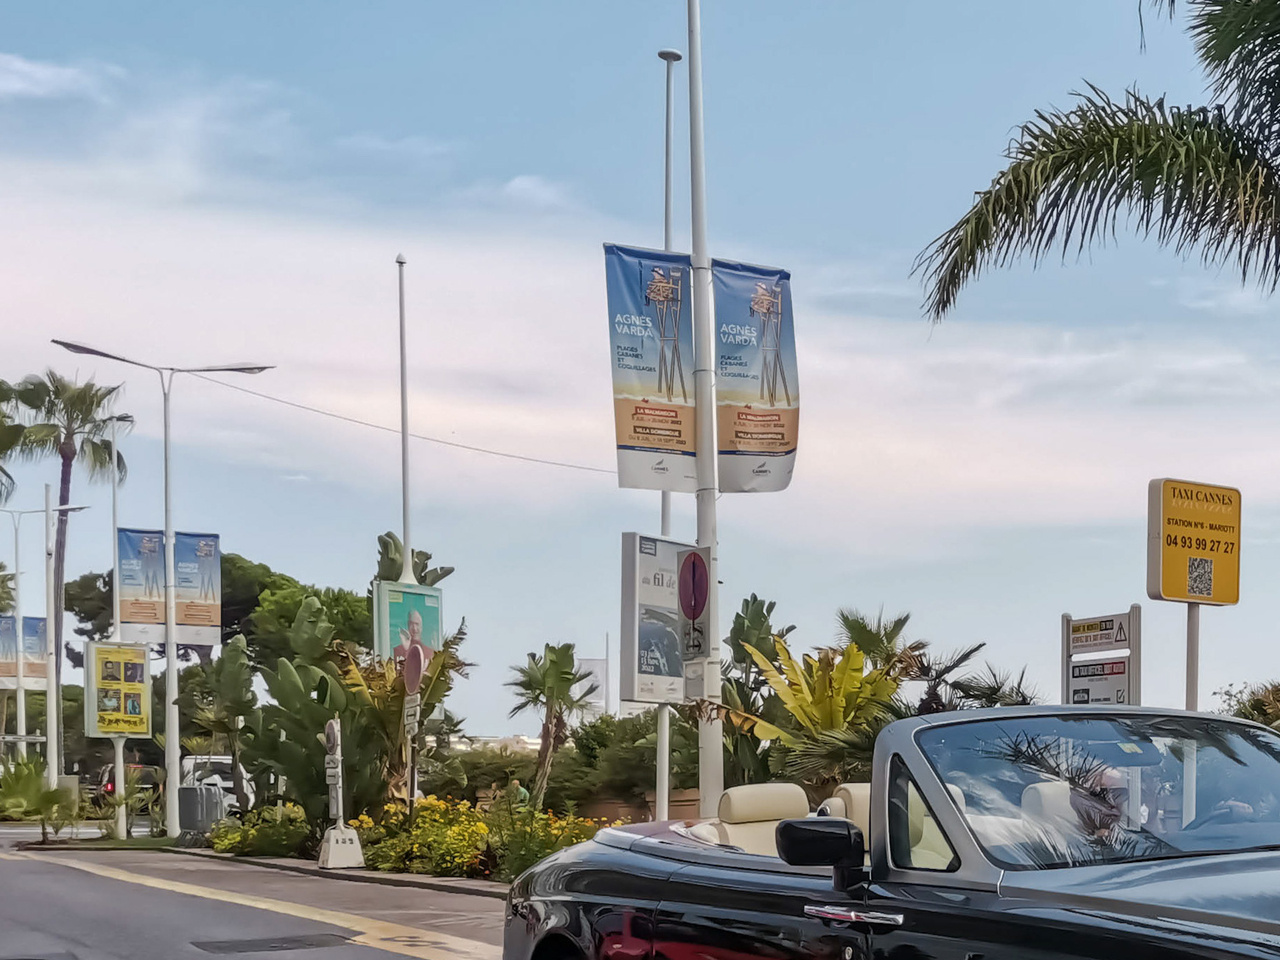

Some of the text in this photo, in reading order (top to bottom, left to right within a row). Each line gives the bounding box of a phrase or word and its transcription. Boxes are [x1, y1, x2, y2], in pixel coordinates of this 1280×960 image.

[615, 313, 652, 327] AGNÈS
[615, 324, 653, 338] VARDA
[720, 323, 757, 337] AGNÈS
[720, 334, 757, 347] VARDA
[1171, 487, 1233, 506] TAXI CANNES
[1167, 517, 1192, 528] STATION
[1166, 534, 1235, 554] 04 93 99 27 27
[653, 572, 663, 587] fil
[666, 575, 675, 589] de
